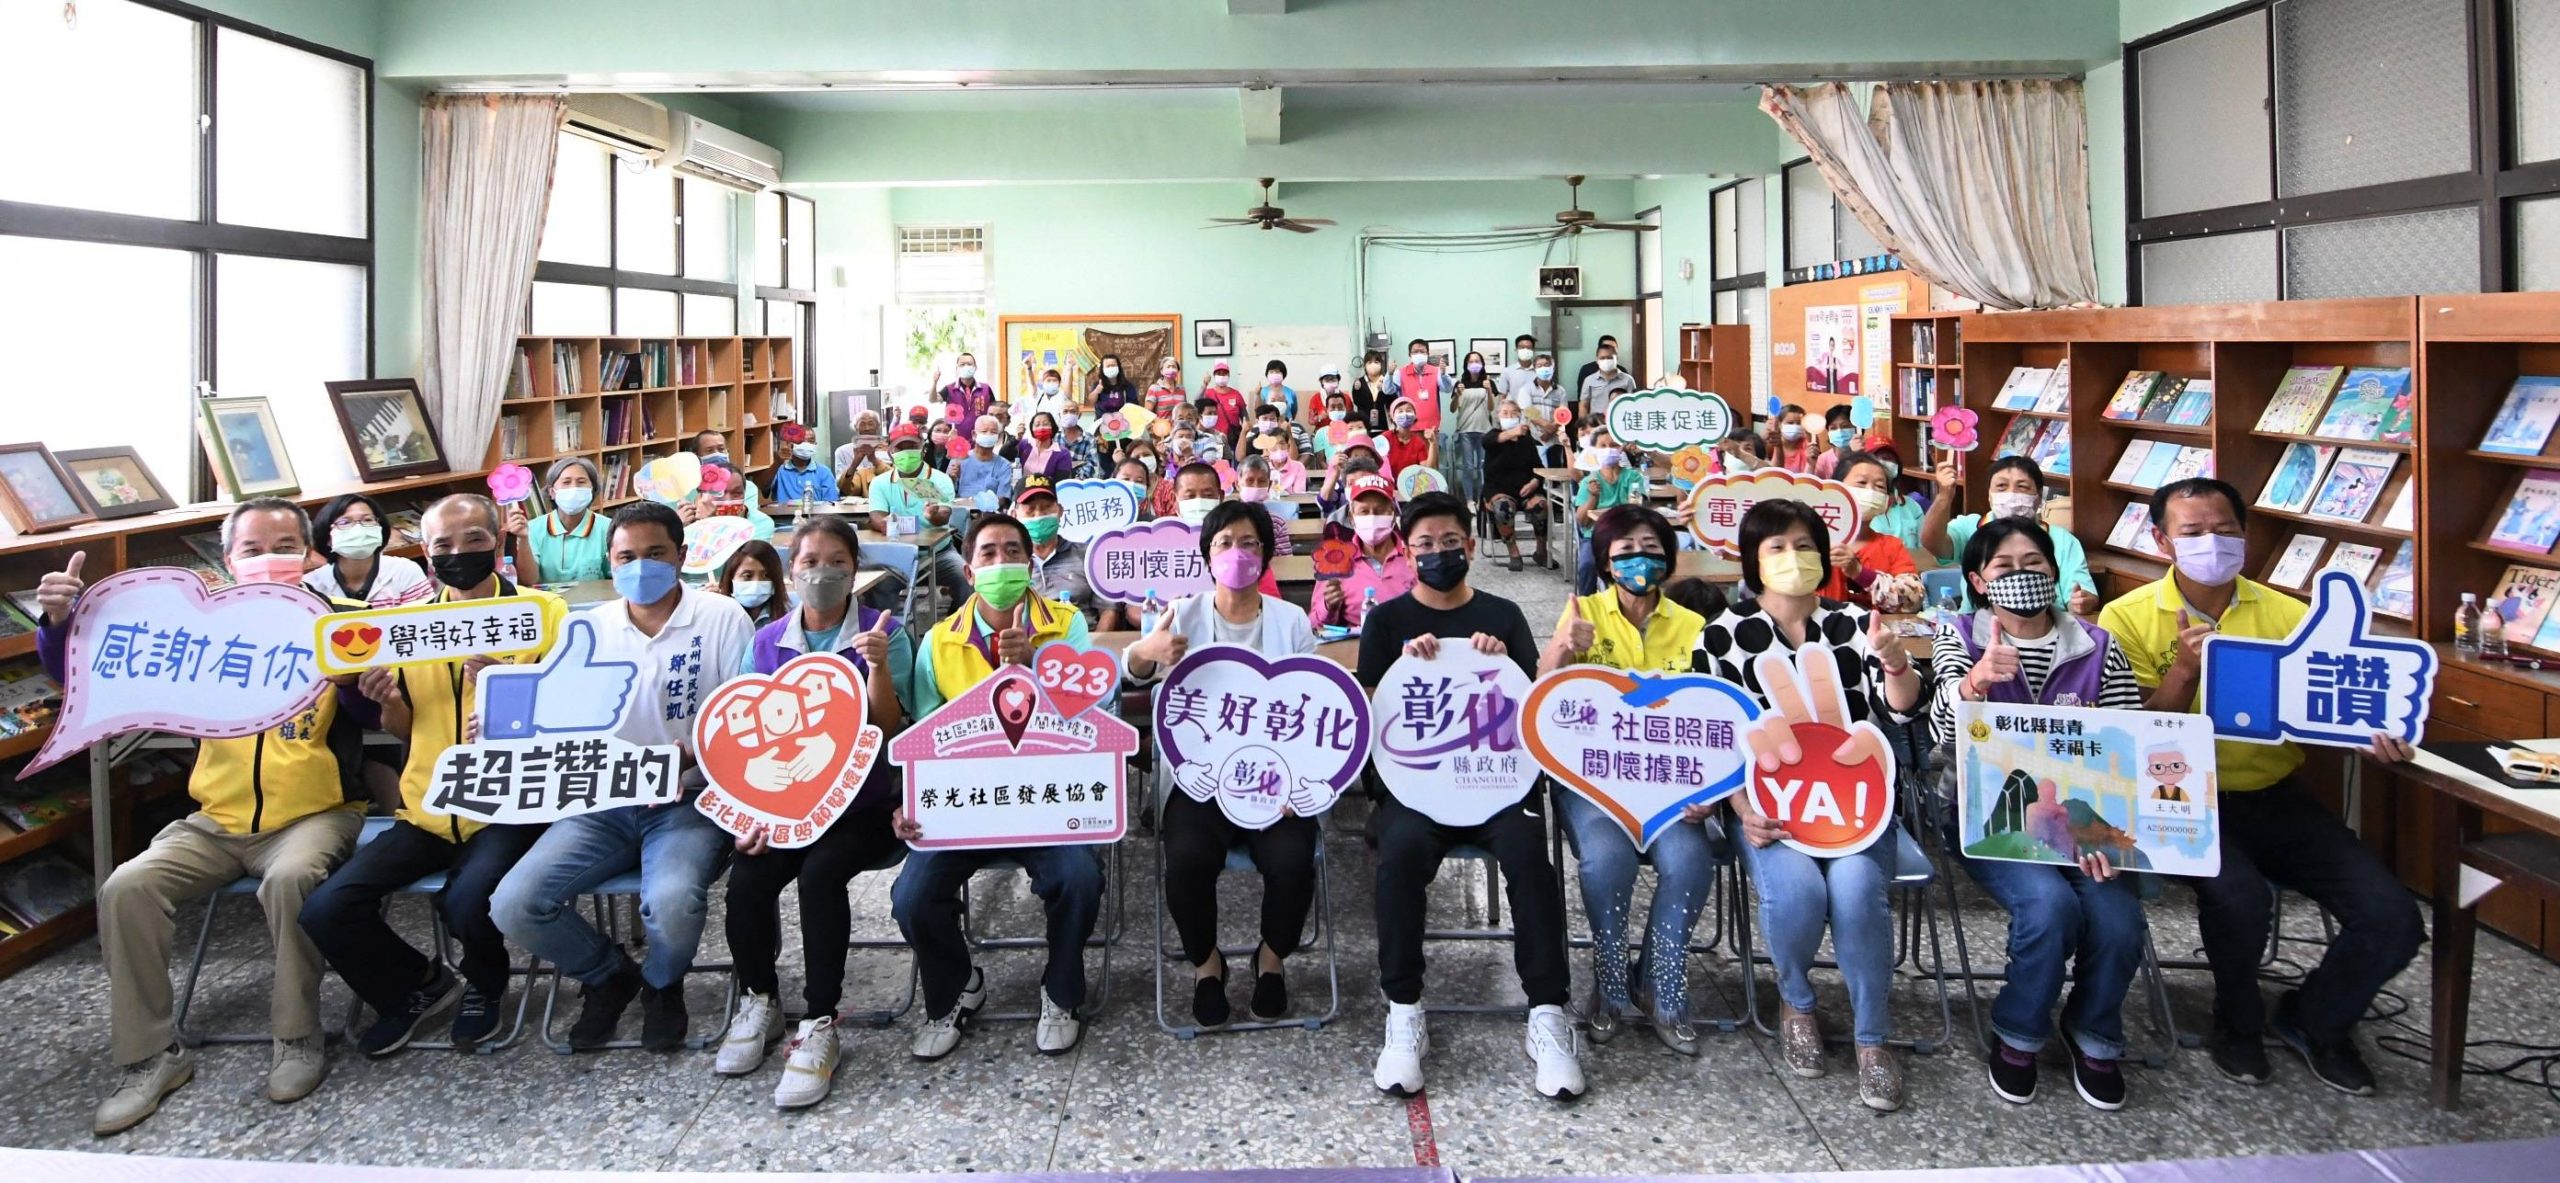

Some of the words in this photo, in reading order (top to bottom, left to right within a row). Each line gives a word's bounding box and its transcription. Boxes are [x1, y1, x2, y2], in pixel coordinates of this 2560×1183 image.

[1622, 410, 1718, 431] 健康促進
[1708, 498, 1841, 531] 電安
[389, 612, 537, 657] 覺得好幸福
[91, 621, 314, 691] 感謝有你
[665, 653, 686, 722] 鄭任凱
[1038, 659, 1110, 697] 323
[2306, 650, 2390, 730] 讚
[935, 717, 995, 745] 社區照顧
[1165, 685, 1355, 752] 美好彰化
[1401, 676, 1516, 753] 彰化
[1611, 711, 1735, 751] 社區照顧
[1995, 715, 2084, 736] 彰化縣長青
[1453, 755, 1517, 774] 縣政府
[2049, 738, 2103, 757] 幸福卡
[431, 739, 672, 816] 超讚的
[1581, 748, 1704, 787] 關懷據點
[920, 780, 1108, 809] 榮光社區發展協會
[1761, 777, 1868, 830] YA!
